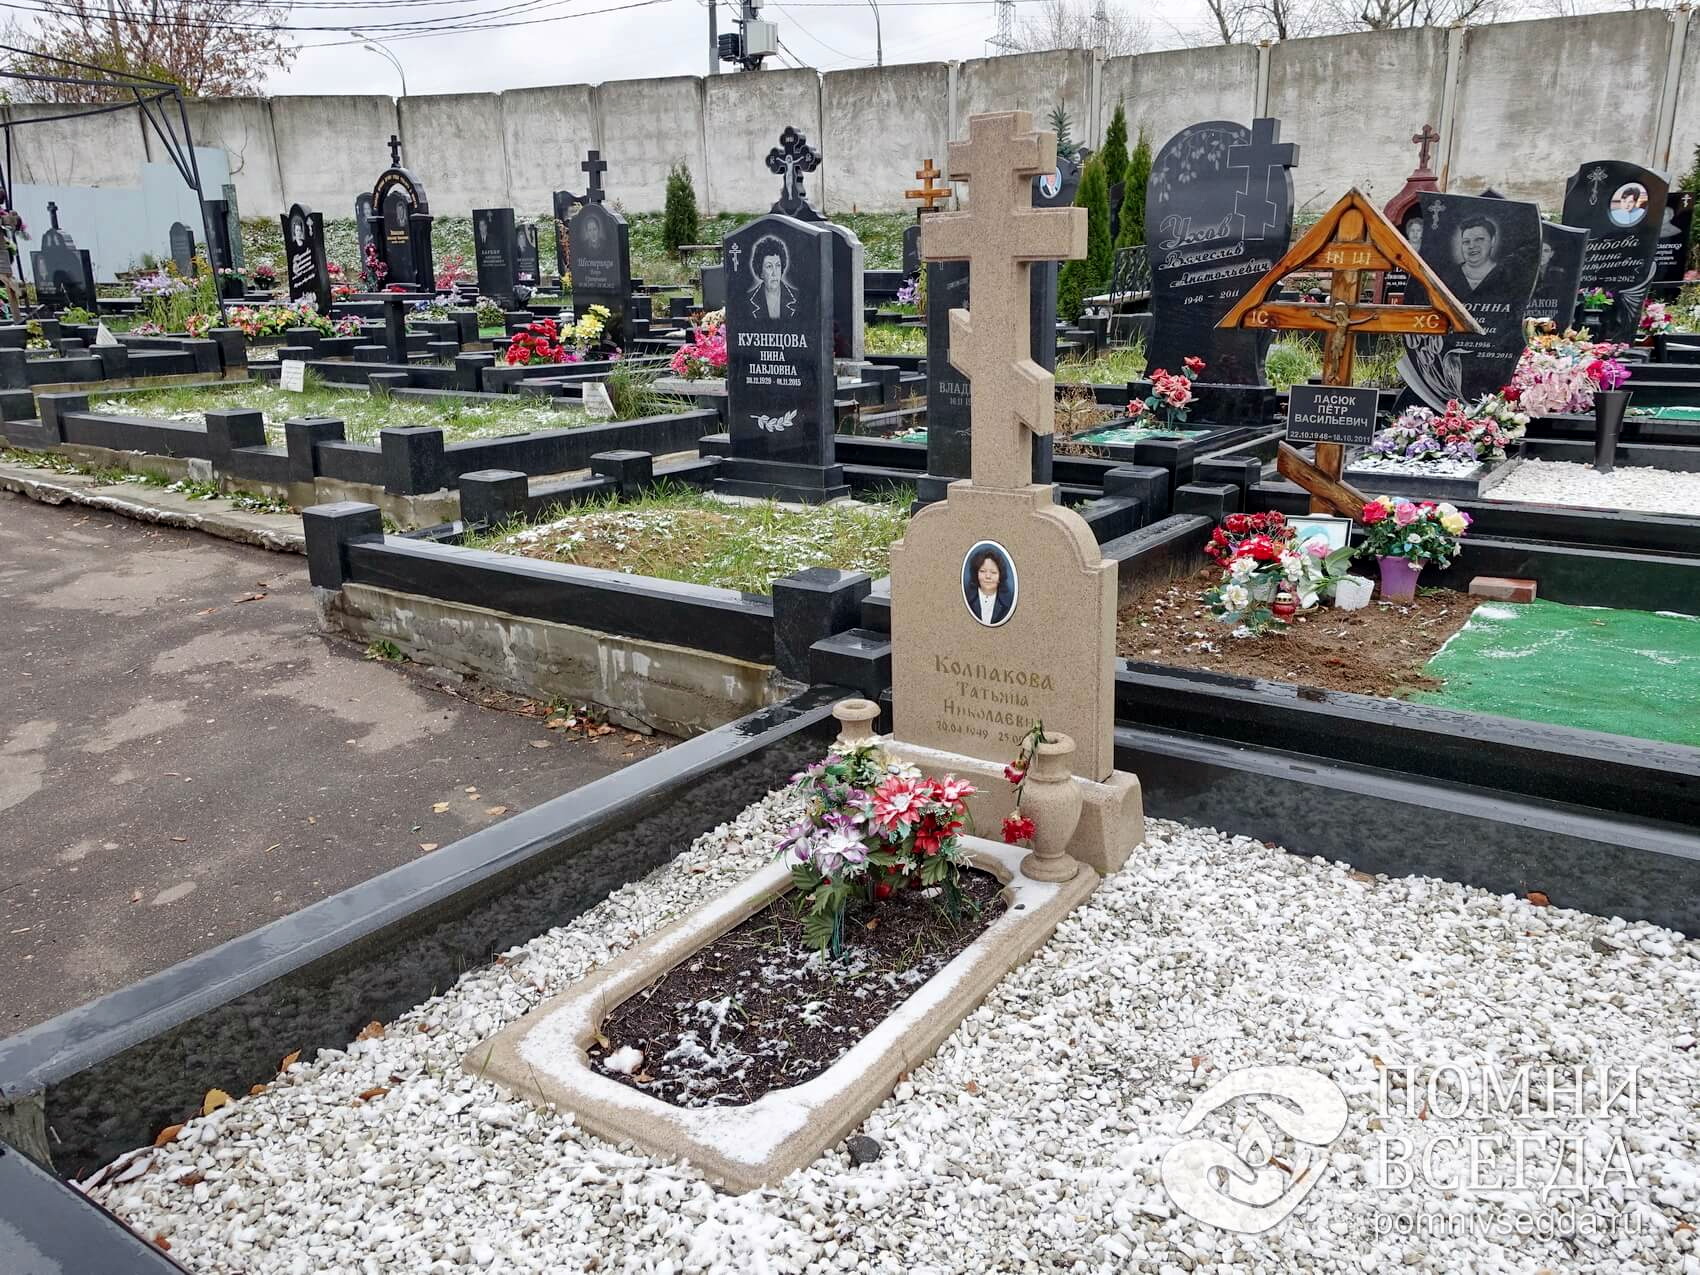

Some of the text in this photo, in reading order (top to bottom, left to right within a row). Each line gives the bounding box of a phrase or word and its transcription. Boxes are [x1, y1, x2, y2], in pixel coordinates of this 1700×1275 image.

[1463, 302, 1511, 313] ОГИНА
[737, 332, 808, 350] КУЗНЕЦОВА
[760, 350, 786, 362] НИНА
[749, 363, 798, 376] ПАВЛОВНА
[939, 382, 970, 396] ВЛАД
[1313, 395, 1357, 406] ЛАСЮК
[1317, 403, 1349, 416] ПЁТР
[1294, 414, 1369, 428] ВАСИЛЬЕВИЧ
[943, 698, 1037, 729] Николаевн
